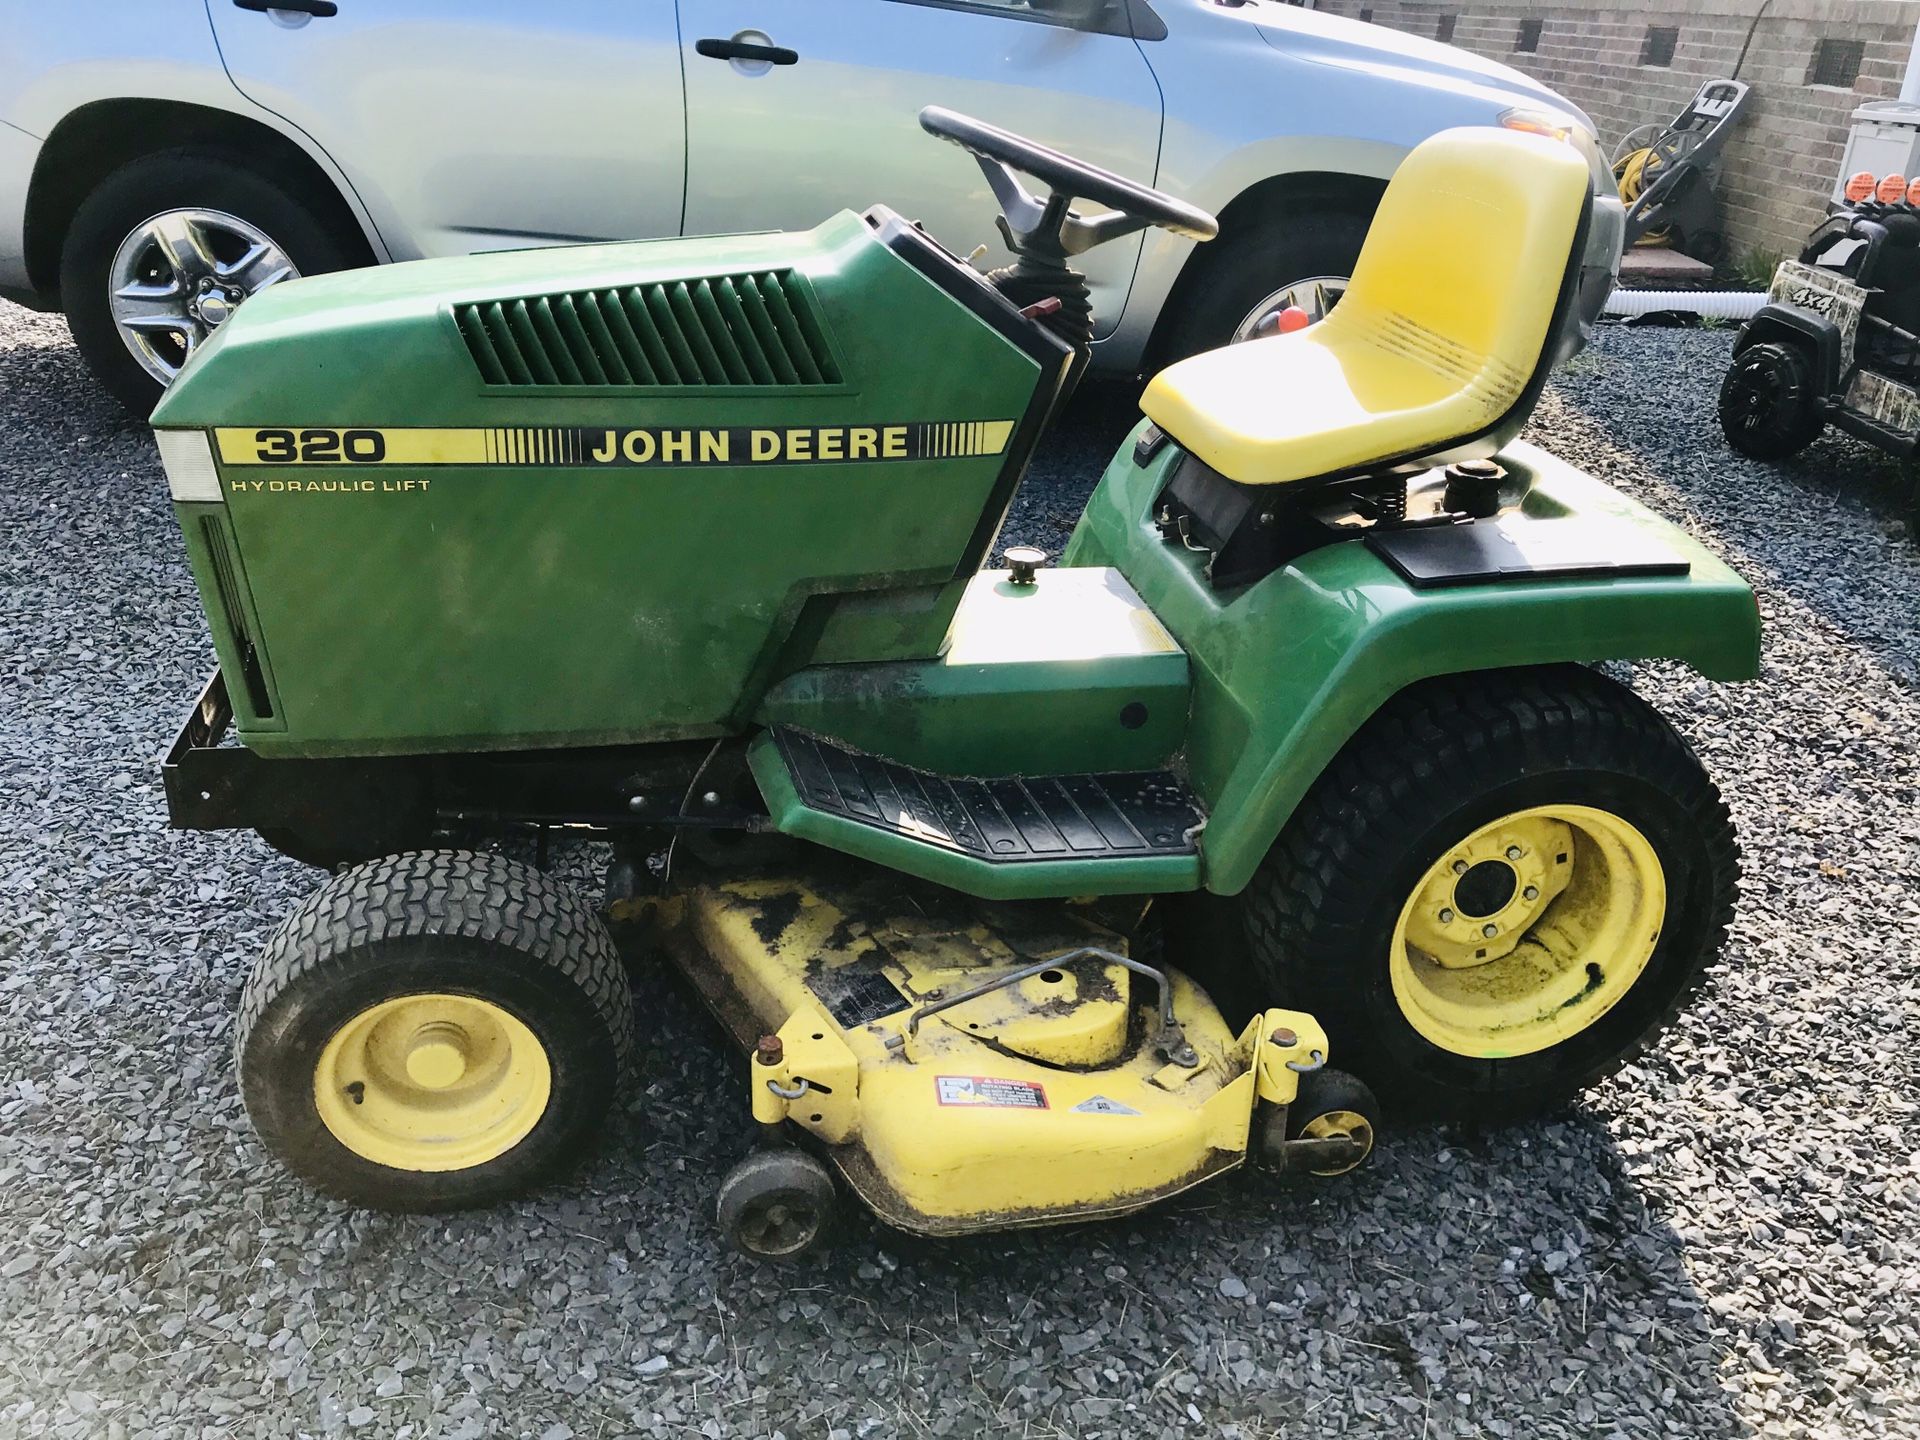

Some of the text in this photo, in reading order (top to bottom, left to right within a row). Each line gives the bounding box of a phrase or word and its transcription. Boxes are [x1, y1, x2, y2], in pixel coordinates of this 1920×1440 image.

[255, 430, 386, 463] 320
[592, 427, 908, 463] JOHN DEERE
[231, 479, 432, 493] HYDRAULIC LIFT
[993, 1079, 1028, 1087] DANGER
